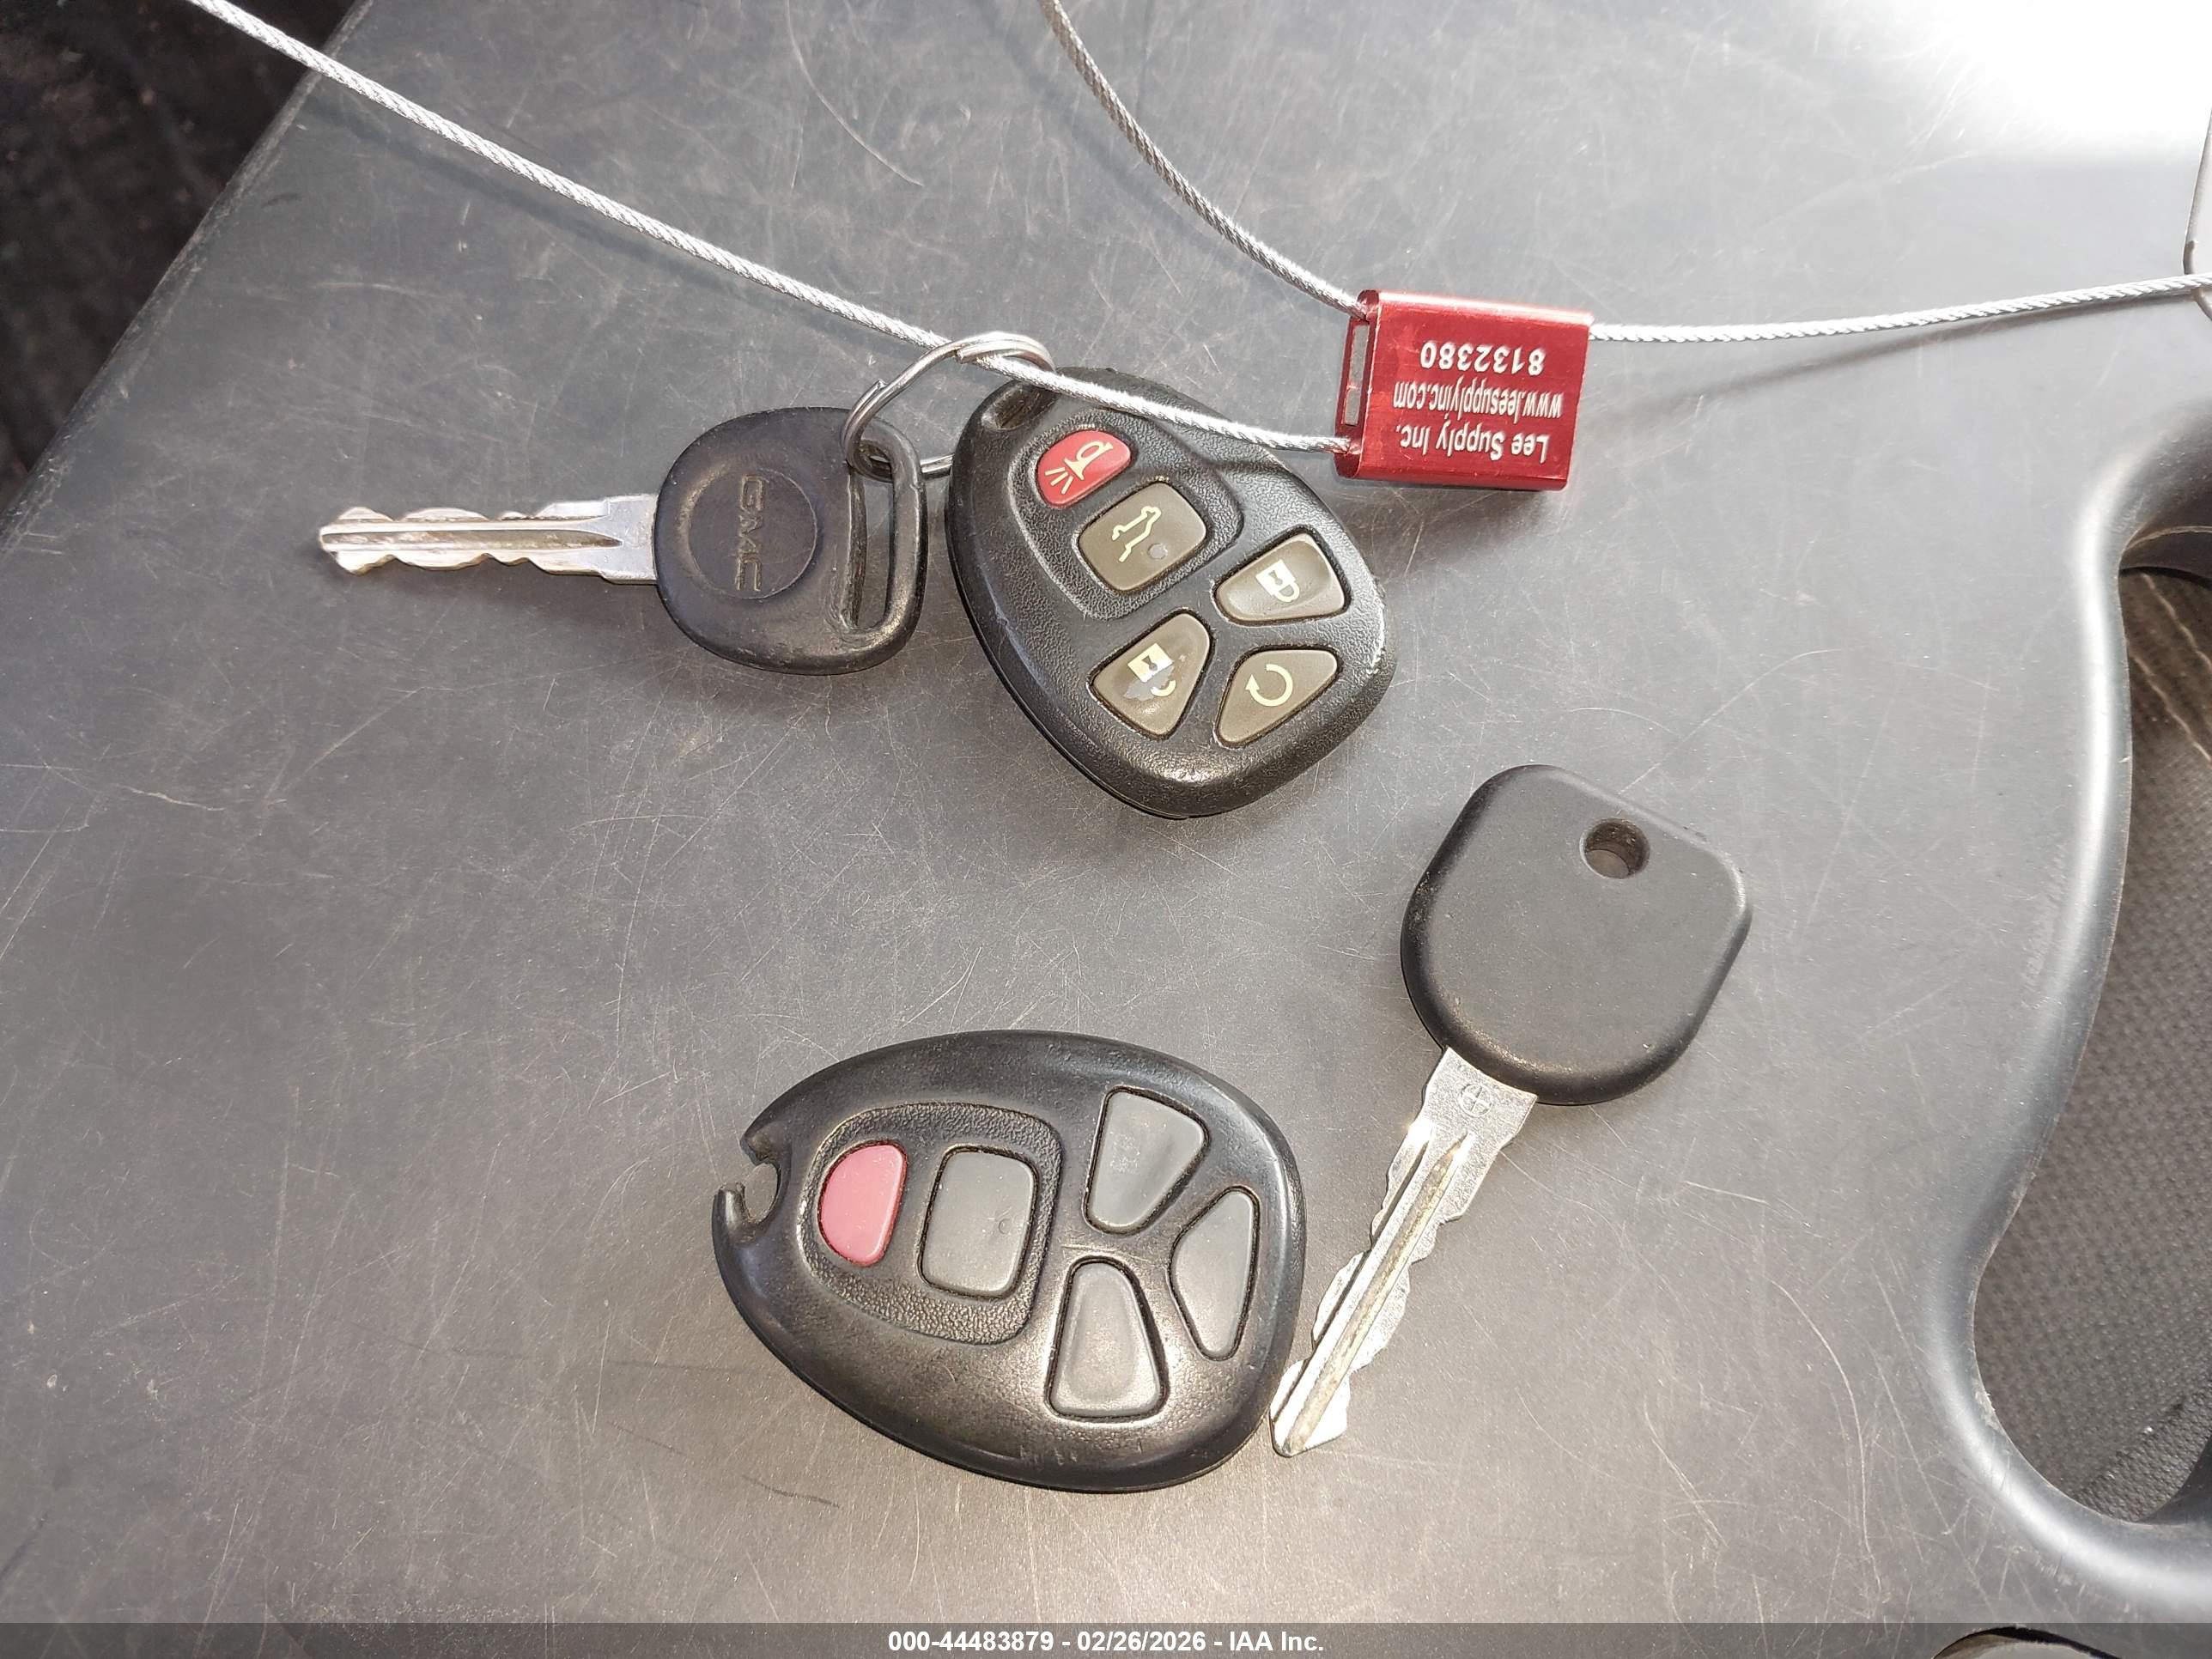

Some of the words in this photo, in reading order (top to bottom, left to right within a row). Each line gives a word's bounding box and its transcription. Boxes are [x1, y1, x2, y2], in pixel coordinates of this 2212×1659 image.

[1419, 341, 1547, 377] 8132380
[1394, 375, 1562, 424] www.leesupplyinc.com
[1396, 424, 1431, 456] Inc.
[1436, 420, 1504, 461] Supply
[1510, 433, 1550, 463] Lee
[734, 473, 767, 592] GMC
